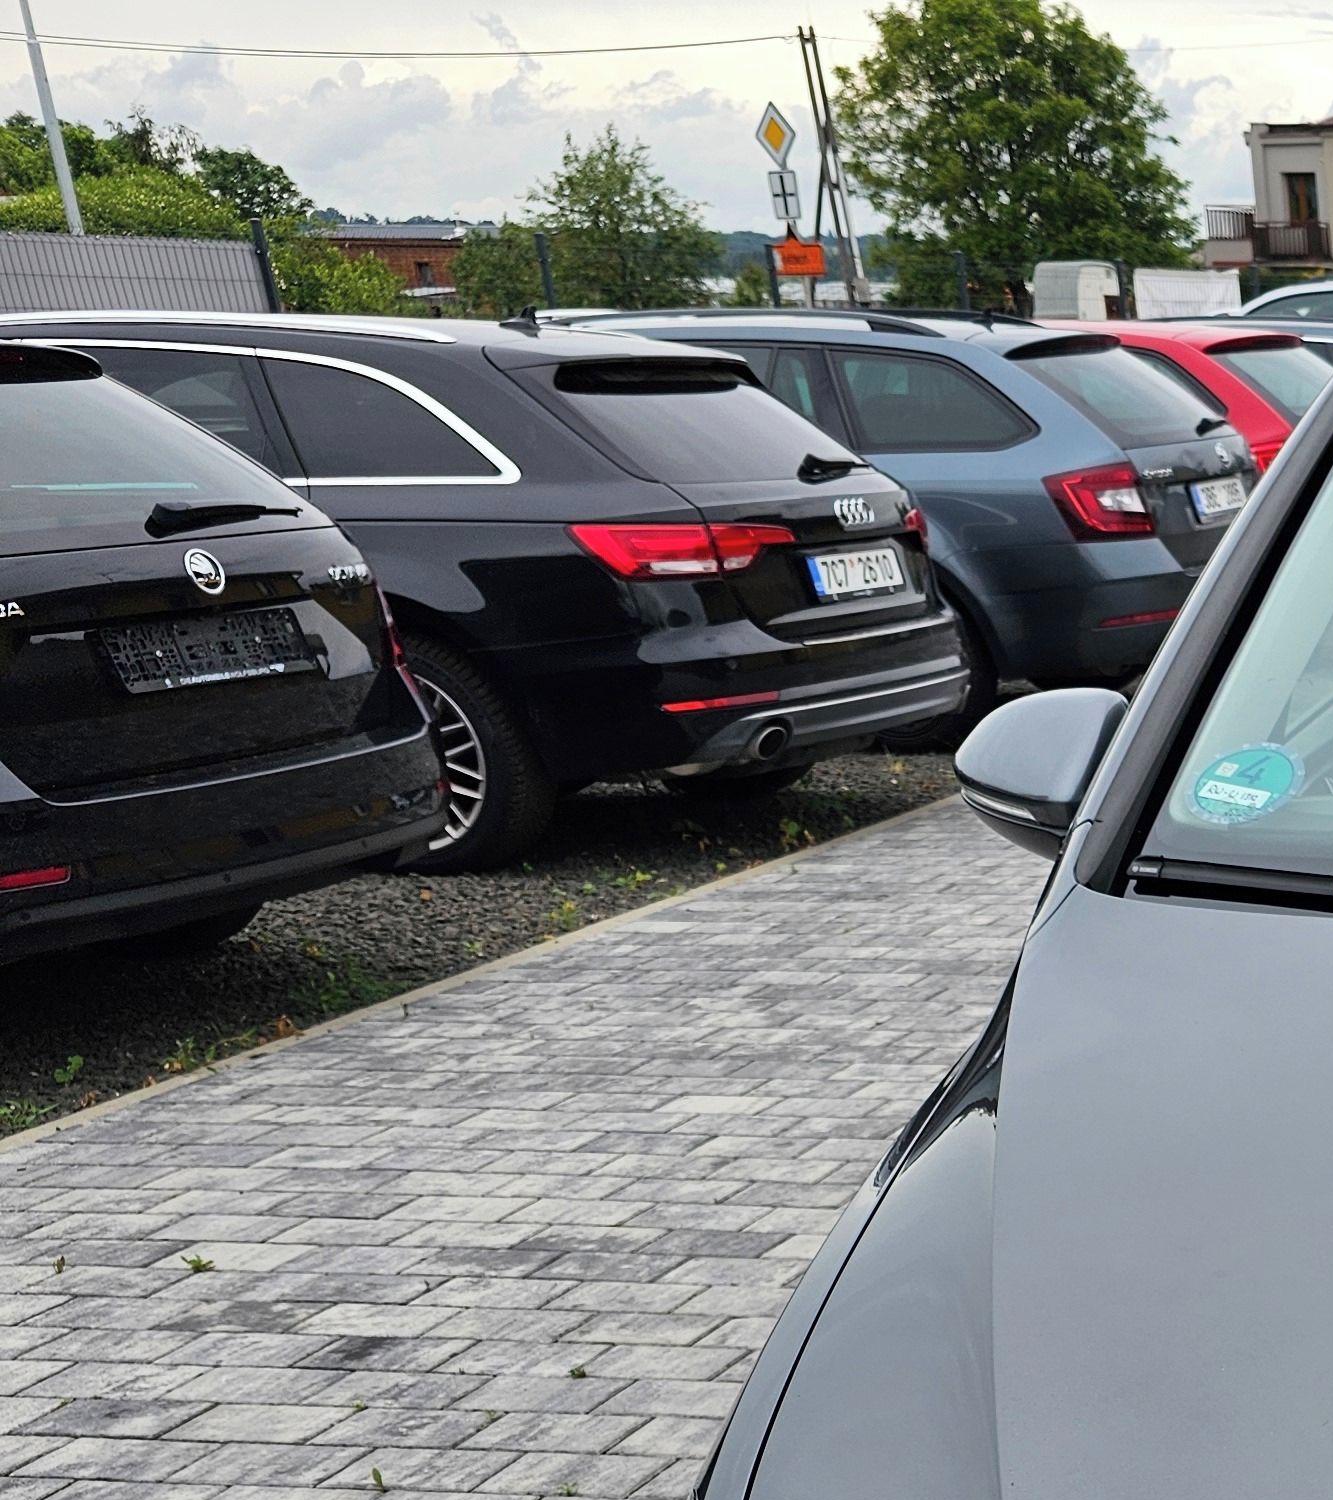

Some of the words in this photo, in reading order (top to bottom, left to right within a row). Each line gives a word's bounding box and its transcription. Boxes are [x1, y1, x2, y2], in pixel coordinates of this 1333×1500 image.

[820, 558, 849, 590] 7C7
[857, 554, 895, 585] 2610
[1237, 755, 1273, 785] 4
